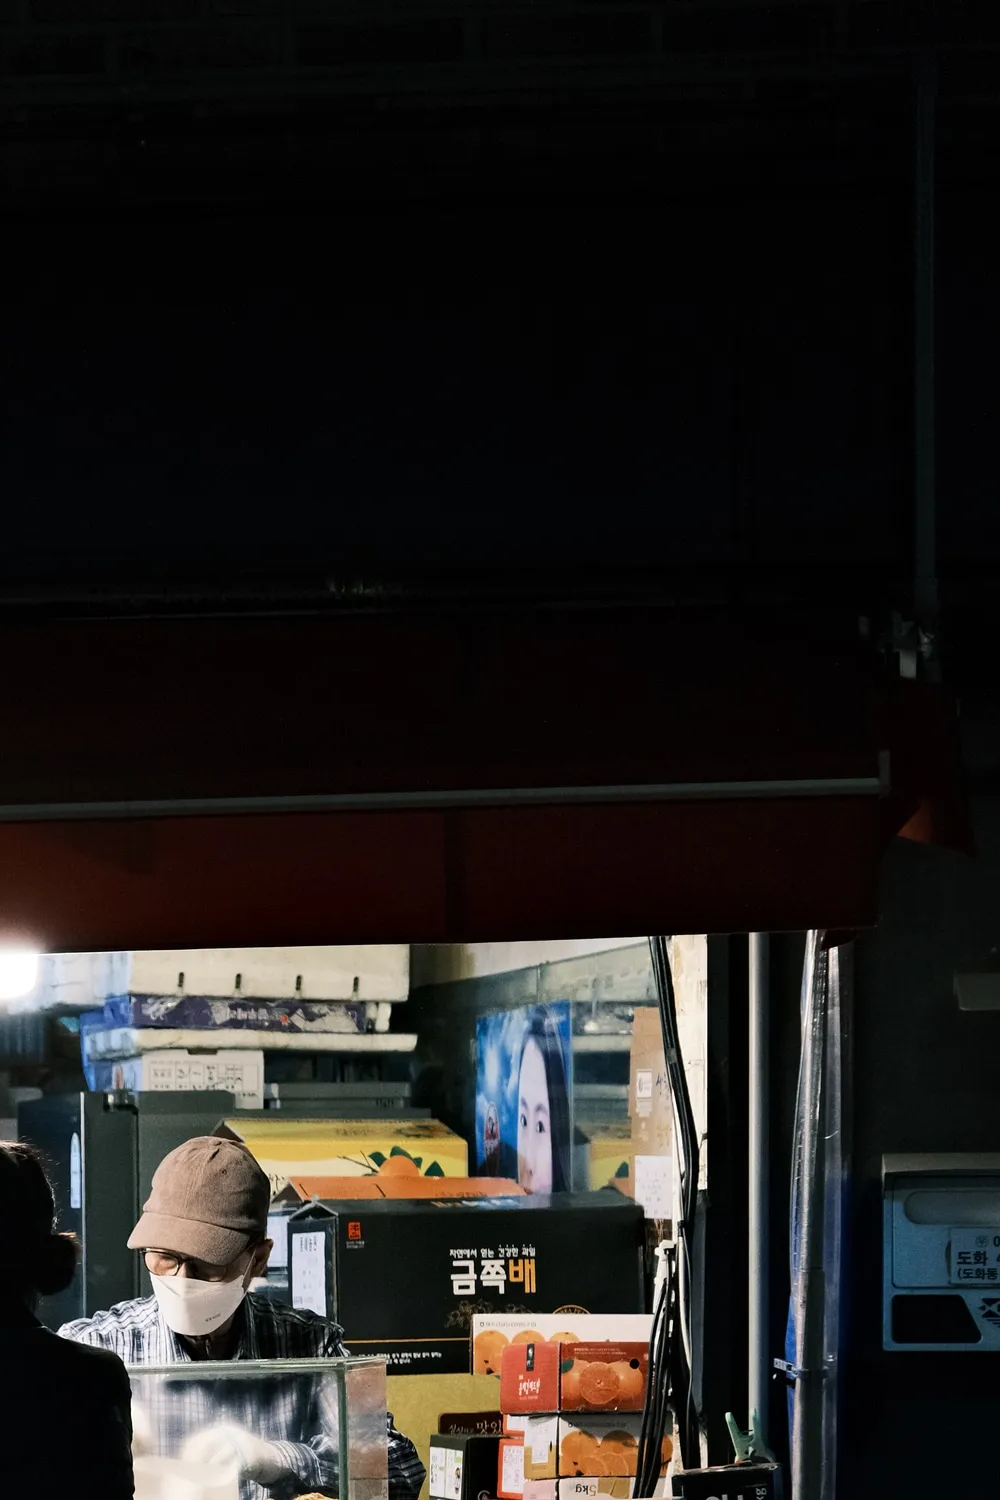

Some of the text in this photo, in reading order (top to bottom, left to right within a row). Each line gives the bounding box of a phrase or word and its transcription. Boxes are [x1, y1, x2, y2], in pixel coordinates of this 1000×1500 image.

[449, 1248, 477, 1259] 자연에서
[498, 1245, 519, 1258] 건강한
[957, 1250, 988, 1266] 도화
[450, 1258, 536, 1295] 금쪽배
[476, 1420, 502, 1434] 맛있
[575, 1484, 597, 1497] 5kg
